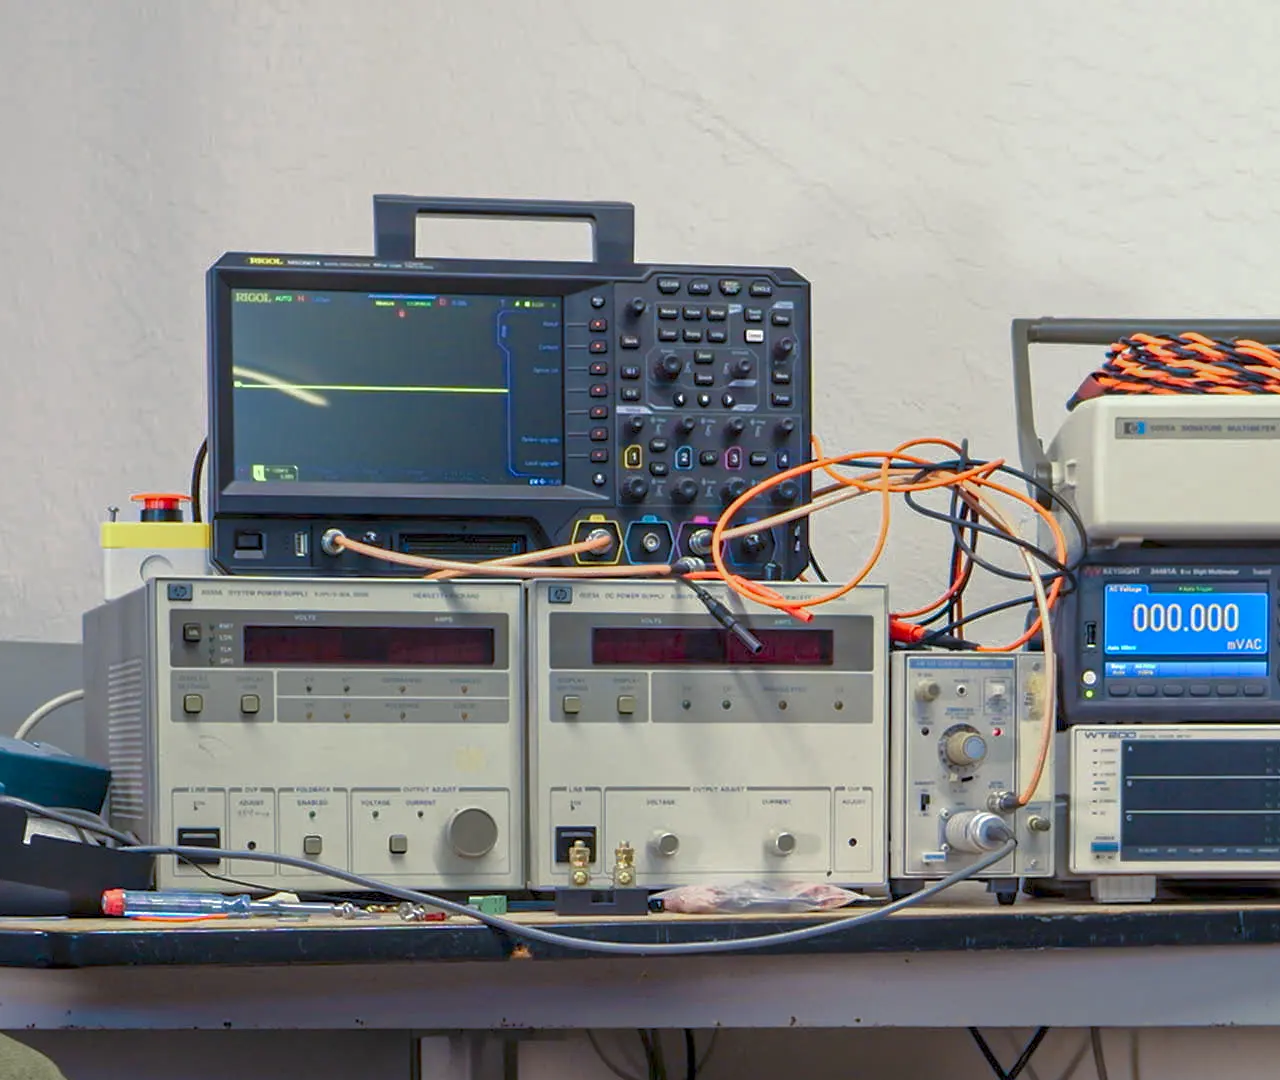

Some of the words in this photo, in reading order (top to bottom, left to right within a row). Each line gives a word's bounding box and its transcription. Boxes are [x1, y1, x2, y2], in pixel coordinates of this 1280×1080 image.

[249, 256, 283, 266] RIGOL
[236, 292, 272, 303] RIGOL
[1181, 424, 1222, 432] SIGNATURE
[1227, 424, 1276, 432] MULTIMETER
[631, 452, 637, 461] 1
[681, 453, 689, 462] 2
[731, 454, 738, 463] 3
[780, 454, 788, 463] 4
[1102, 567, 1140, 576] KEYSIGHT
[1207, 568, 1240, 576] Multimeter
[257, 590, 282, 598] POWER
[1119, 586, 1143, 594] Voltage
[641, 592, 665, 600] SUPPLY
[1132, 603, 1240, 632] 000.000
[1226, 638, 1263, 651] mVAC
[1084, 731, 1137, 739] WT200
